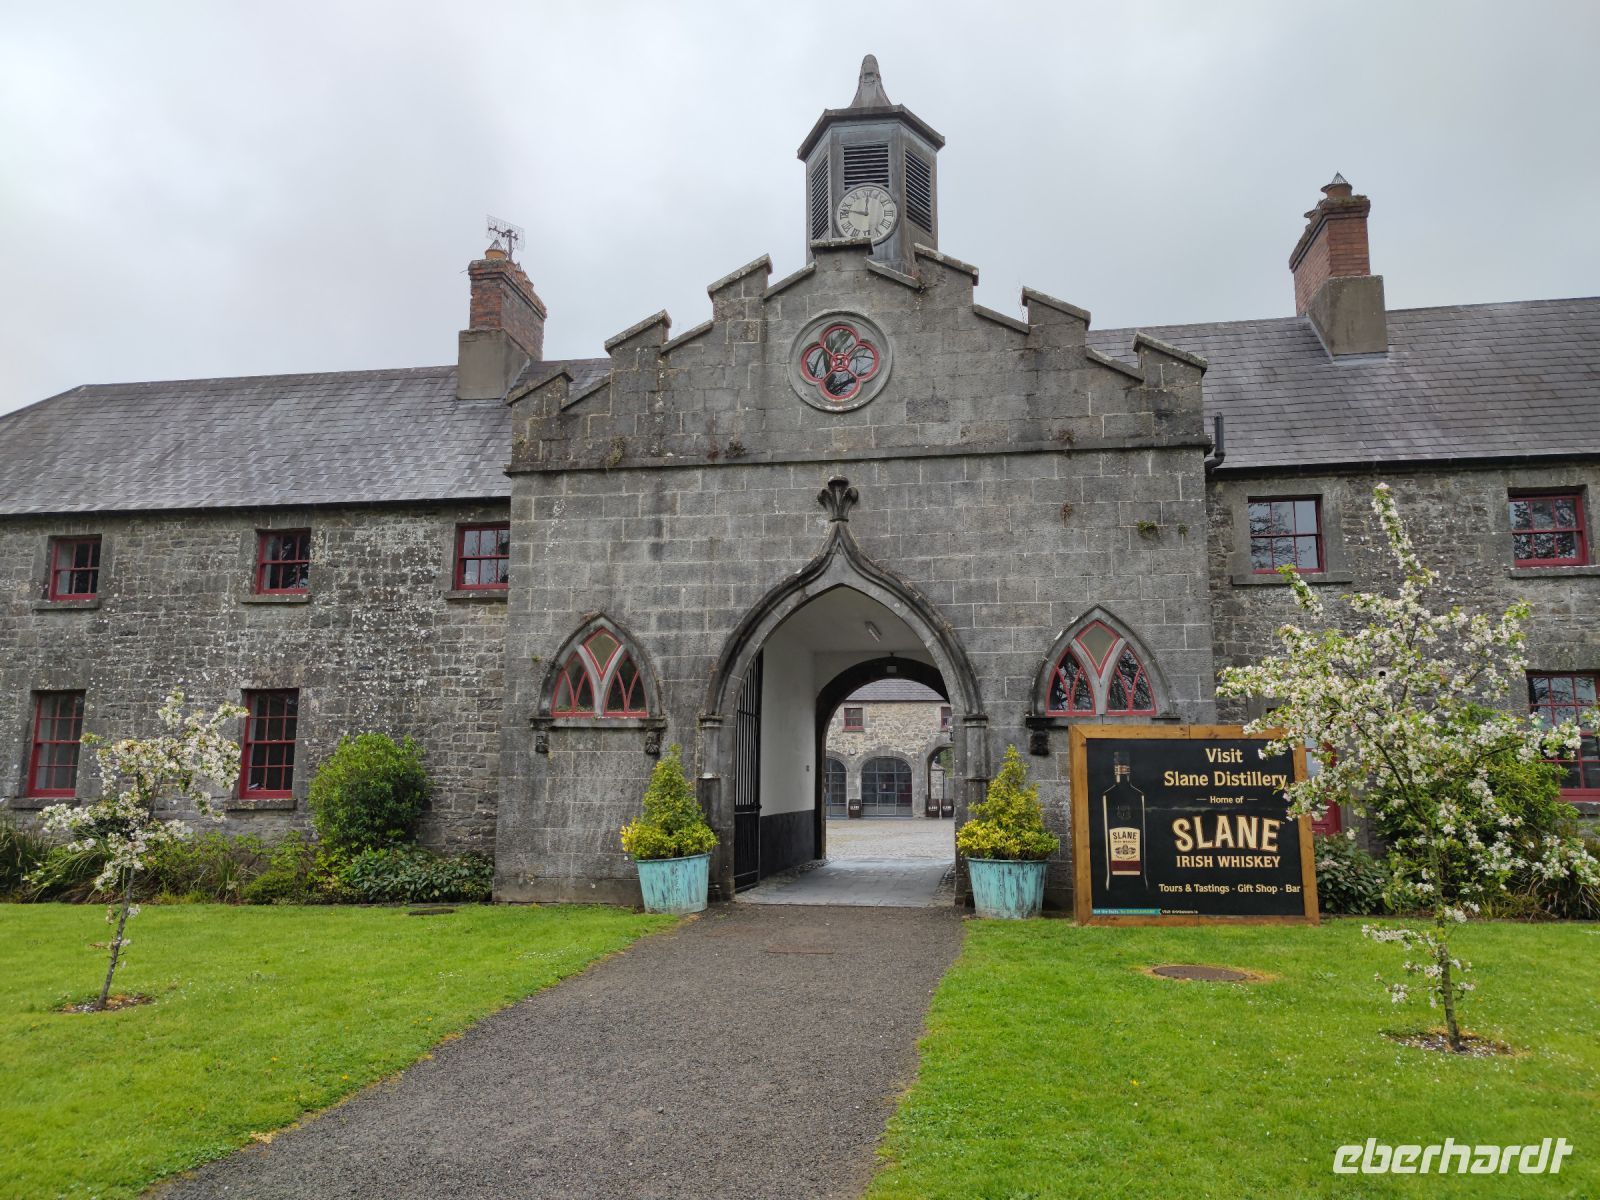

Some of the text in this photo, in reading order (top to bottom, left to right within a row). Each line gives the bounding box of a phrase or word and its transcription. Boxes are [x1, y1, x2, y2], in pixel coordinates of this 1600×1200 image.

[1205, 748, 1244, 763] Visit
[1164, 771, 1287, 789] Slane Distillery
[1209, 796, 1244, 804] Home of
[1112, 831, 1137, 840] SLANE
[1172, 815, 1280, 852] SLANE
[1176, 856, 1281, 868] IRISH WHISKEY
[1159, 884, 1183, 892] Tours
[1185, 884, 1193, 893] &
[1194, 884, 1230, 895] Tastings
[1237, 884, 1254, 893] Gift
[1256, 884, 1278, 895] Shop
[1285, 885, 1301, 893] Bar
